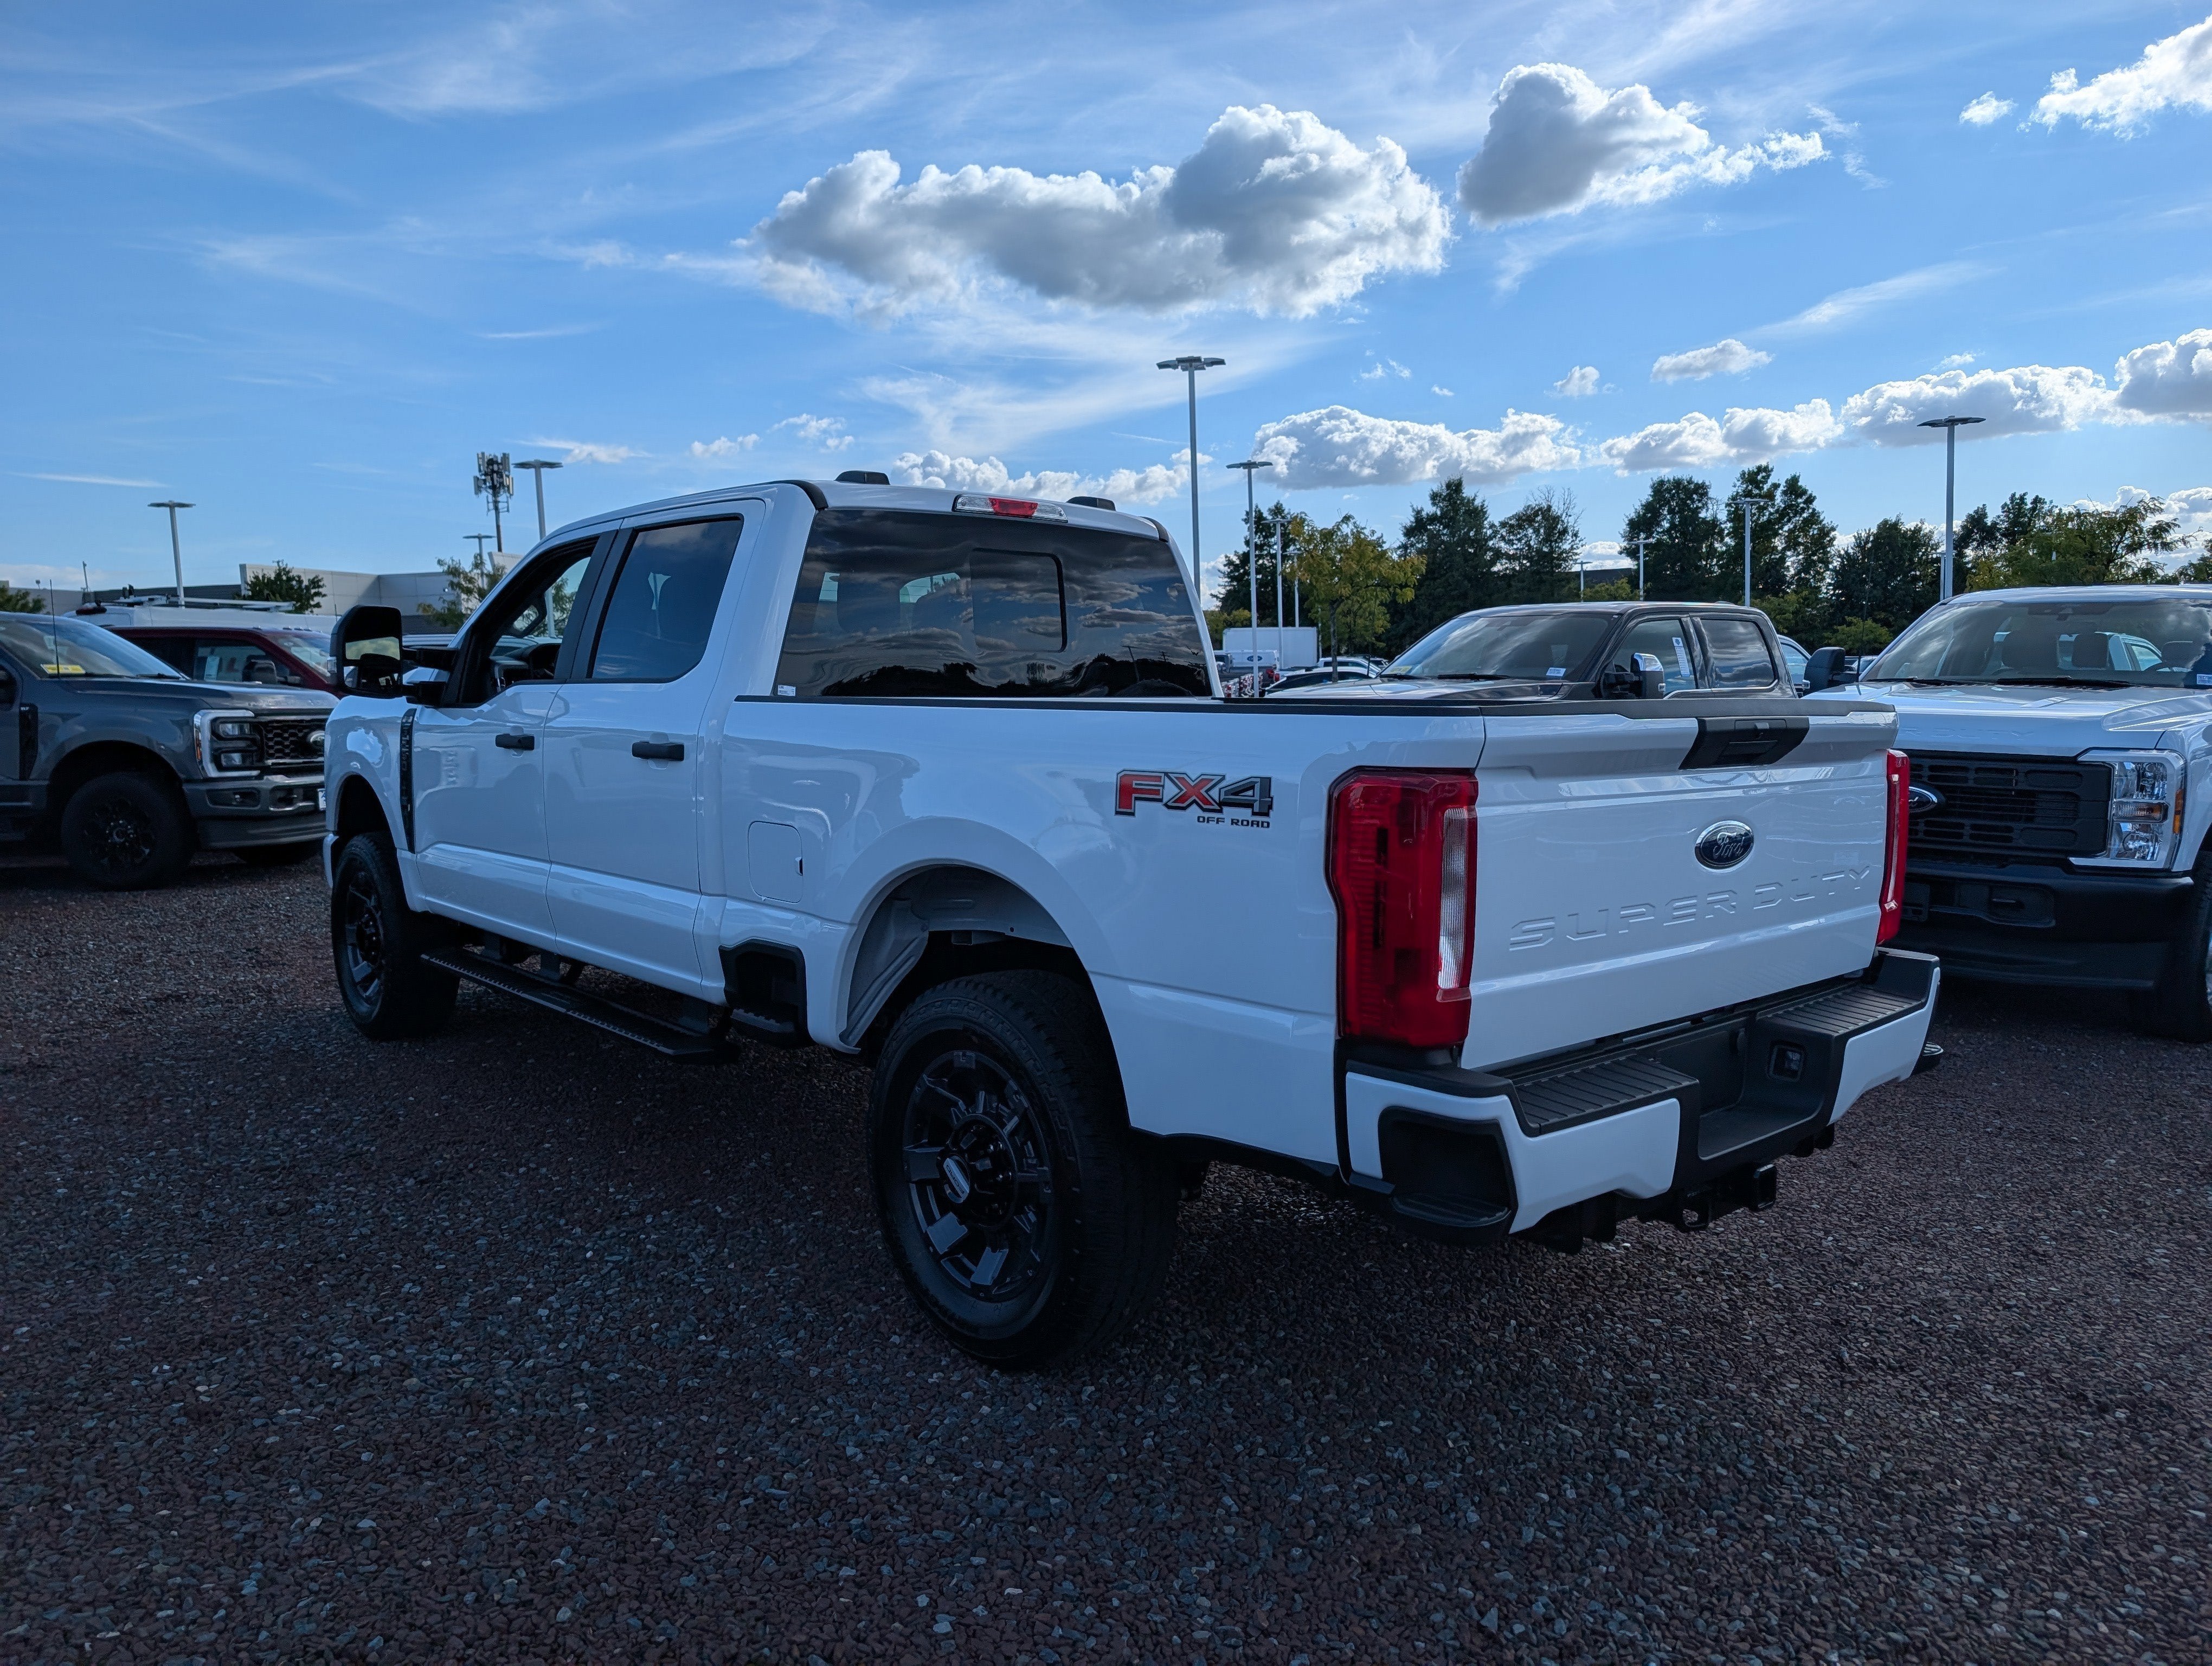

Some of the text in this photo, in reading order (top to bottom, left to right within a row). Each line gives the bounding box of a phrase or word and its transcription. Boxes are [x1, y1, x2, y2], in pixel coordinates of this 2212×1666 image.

[1115, 768, 1274, 818] FX4
[1197, 815, 1271, 829] OFF ROAD
[1509, 866, 1870, 952] SUPER DUTY
[946, 1164, 965, 1195] FORD
